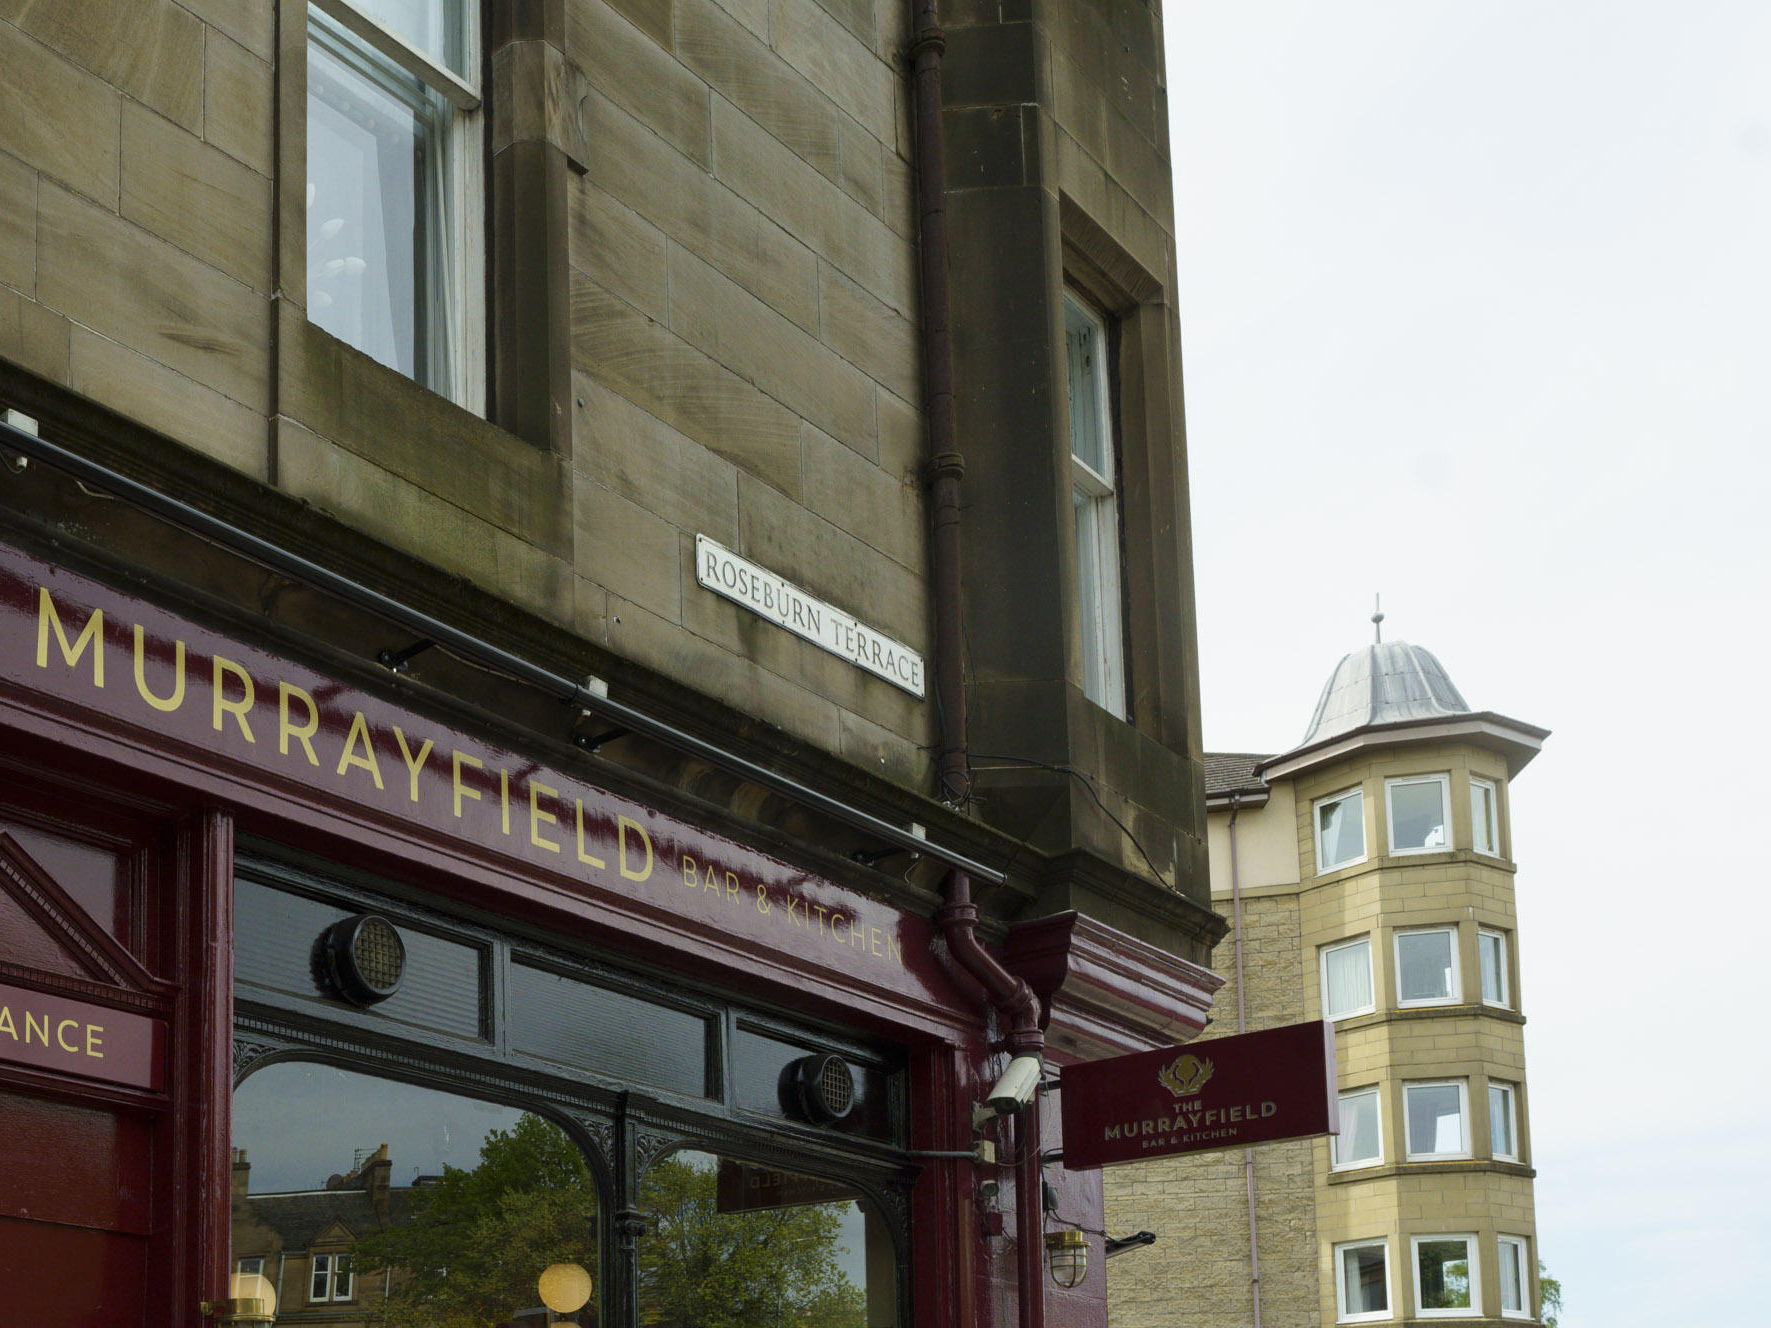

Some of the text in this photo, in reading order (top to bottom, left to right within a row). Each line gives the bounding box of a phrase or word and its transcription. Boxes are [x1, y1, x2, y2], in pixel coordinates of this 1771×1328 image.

[704, 552, 922, 689] ROSEBURN TERRACE
[36, 586, 655, 882] MURRAYFIELD
[681, 854, 741, 904] BAR
[754, 881, 773, 916] &
[784, 894, 902, 964] KITCHEN
[1104, 1101, 1277, 1141] MURRAYFIELD
[1173, 1099, 1203, 1113] THE
[1141, 1127, 1238, 1149] BAR & KITCHEN
